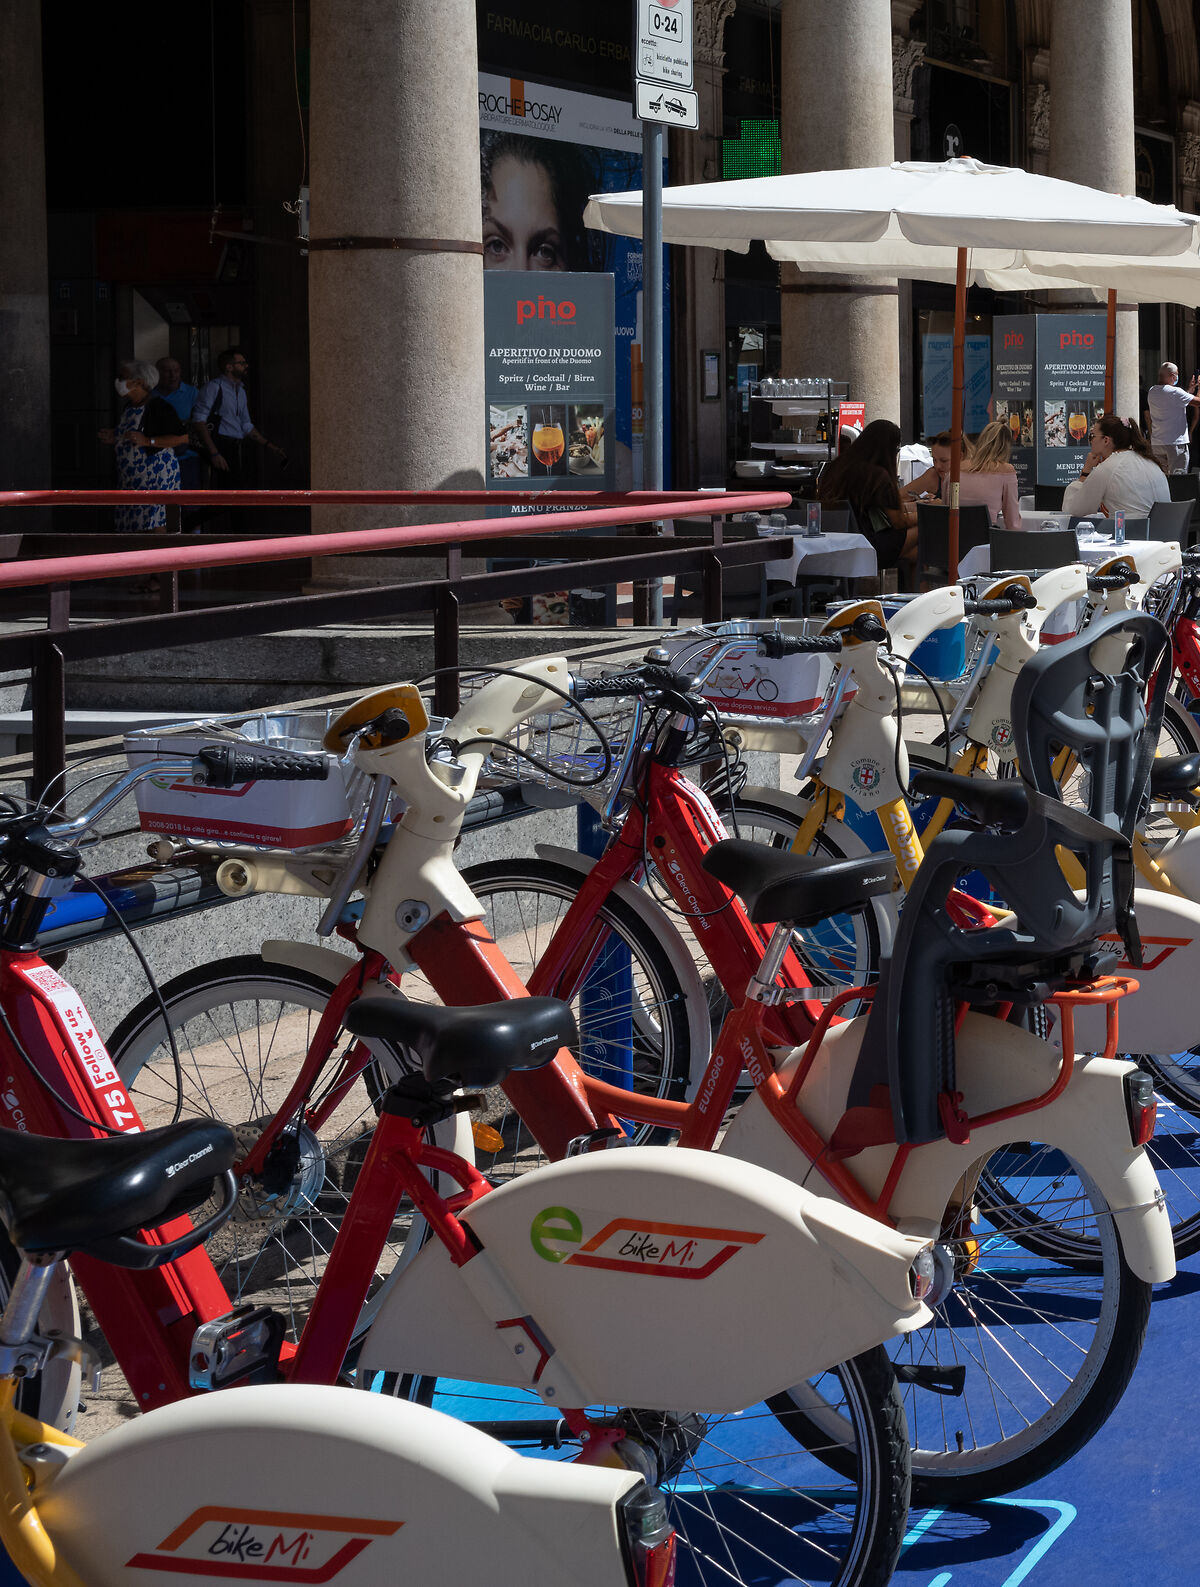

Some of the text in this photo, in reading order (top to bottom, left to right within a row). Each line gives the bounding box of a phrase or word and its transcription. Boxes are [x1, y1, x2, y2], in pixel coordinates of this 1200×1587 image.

[487, 12, 552, 44] FARMACIA
[555, 30, 597, 54] CARLO
[489, 348, 602, 357] APERITIVO IN DUOMO
[499, 374, 524, 384] Spritz
[532, 374, 565, 382] Cocktail
[574, 374, 595, 382] Birra
[525, 383, 547, 391] Wine
[511, 505, 543, 513] MENU
[850, 758, 880, 767] Comune
[849, 784, 880, 797] Milano
[149, 820, 182, 830] 2008-2018
[229, 831, 255, 839] continua
[262, 834, 282, 842] girare!
[675, 873, 690, 896] Clear
[65, 1009, 105, 1085] Follow us
[741, 1037, 765, 1087] 30105
[174, 1143, 213, 1171] Clear Channel
[618, 1233, 698, 1265] bikeMi
[208, 1524, 313, 1566] bikeMi
